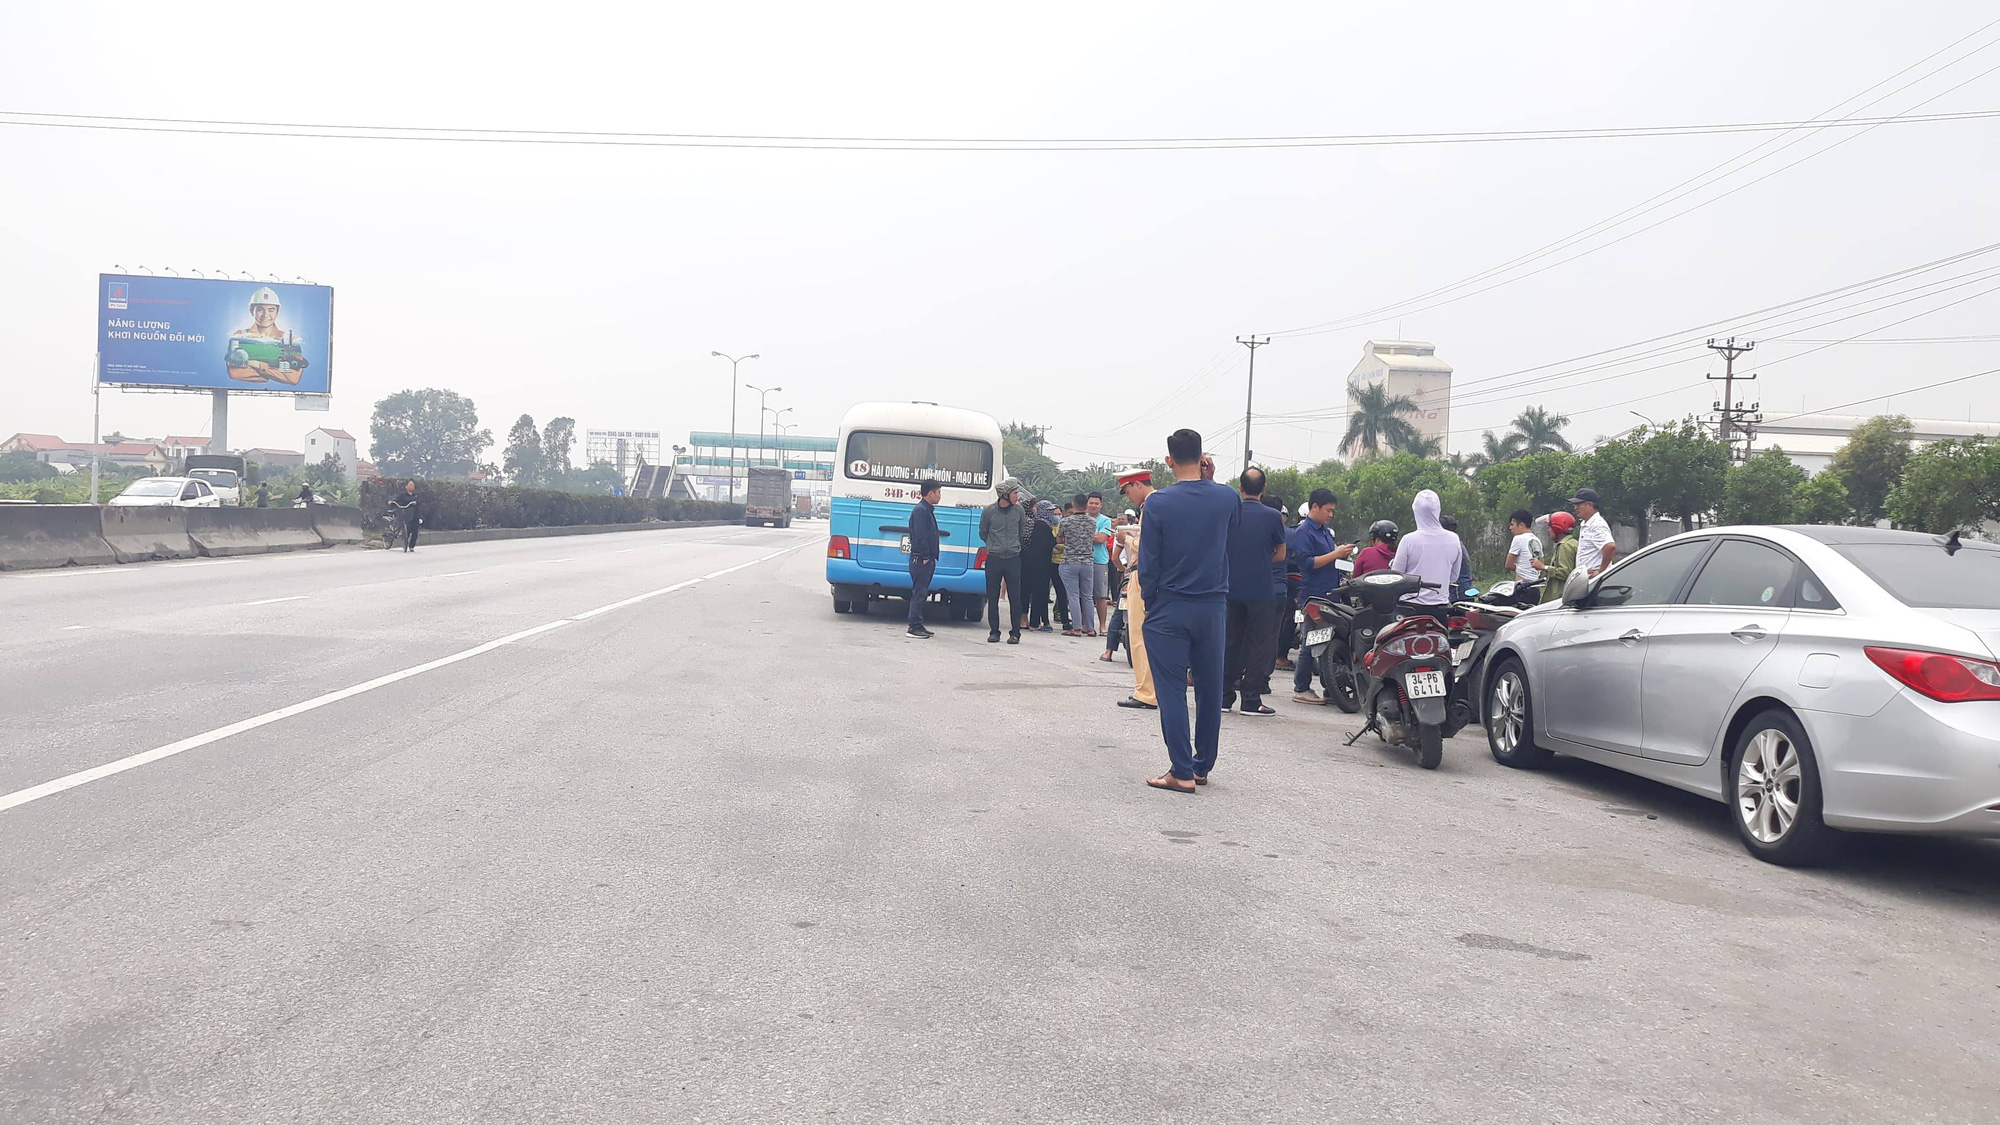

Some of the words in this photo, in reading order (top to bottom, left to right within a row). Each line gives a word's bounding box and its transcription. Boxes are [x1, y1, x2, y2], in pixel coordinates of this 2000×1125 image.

[108, 317, 135, 328] NĂNG
[137, 320, 171, 331] LƯỢNG
[108, 331, 131, 339] KHƠI
[133, 330, 167, 341] NGUỒN
[169, 331, 185, 342] ĐỔI
[187, 333, 205, 343] MỚI
[854, 462, 868, 473] 18
[871, 461, 884, 477] HẢI
[885, 464, 910, 479] DƯƠNG
[914, 467, 933, 480] KINH
[934, 467, 952, 483] MÔN
[955, 471, 972, 485] MẠO
[973, 470, 988, 485] KHÊ
[884, 487, 904, 499] 34B
[910, 489, 922, 500] 02
[1411, 673, 1438, 685] 34-P6
[1413, 684, 1441, 696] 6414
